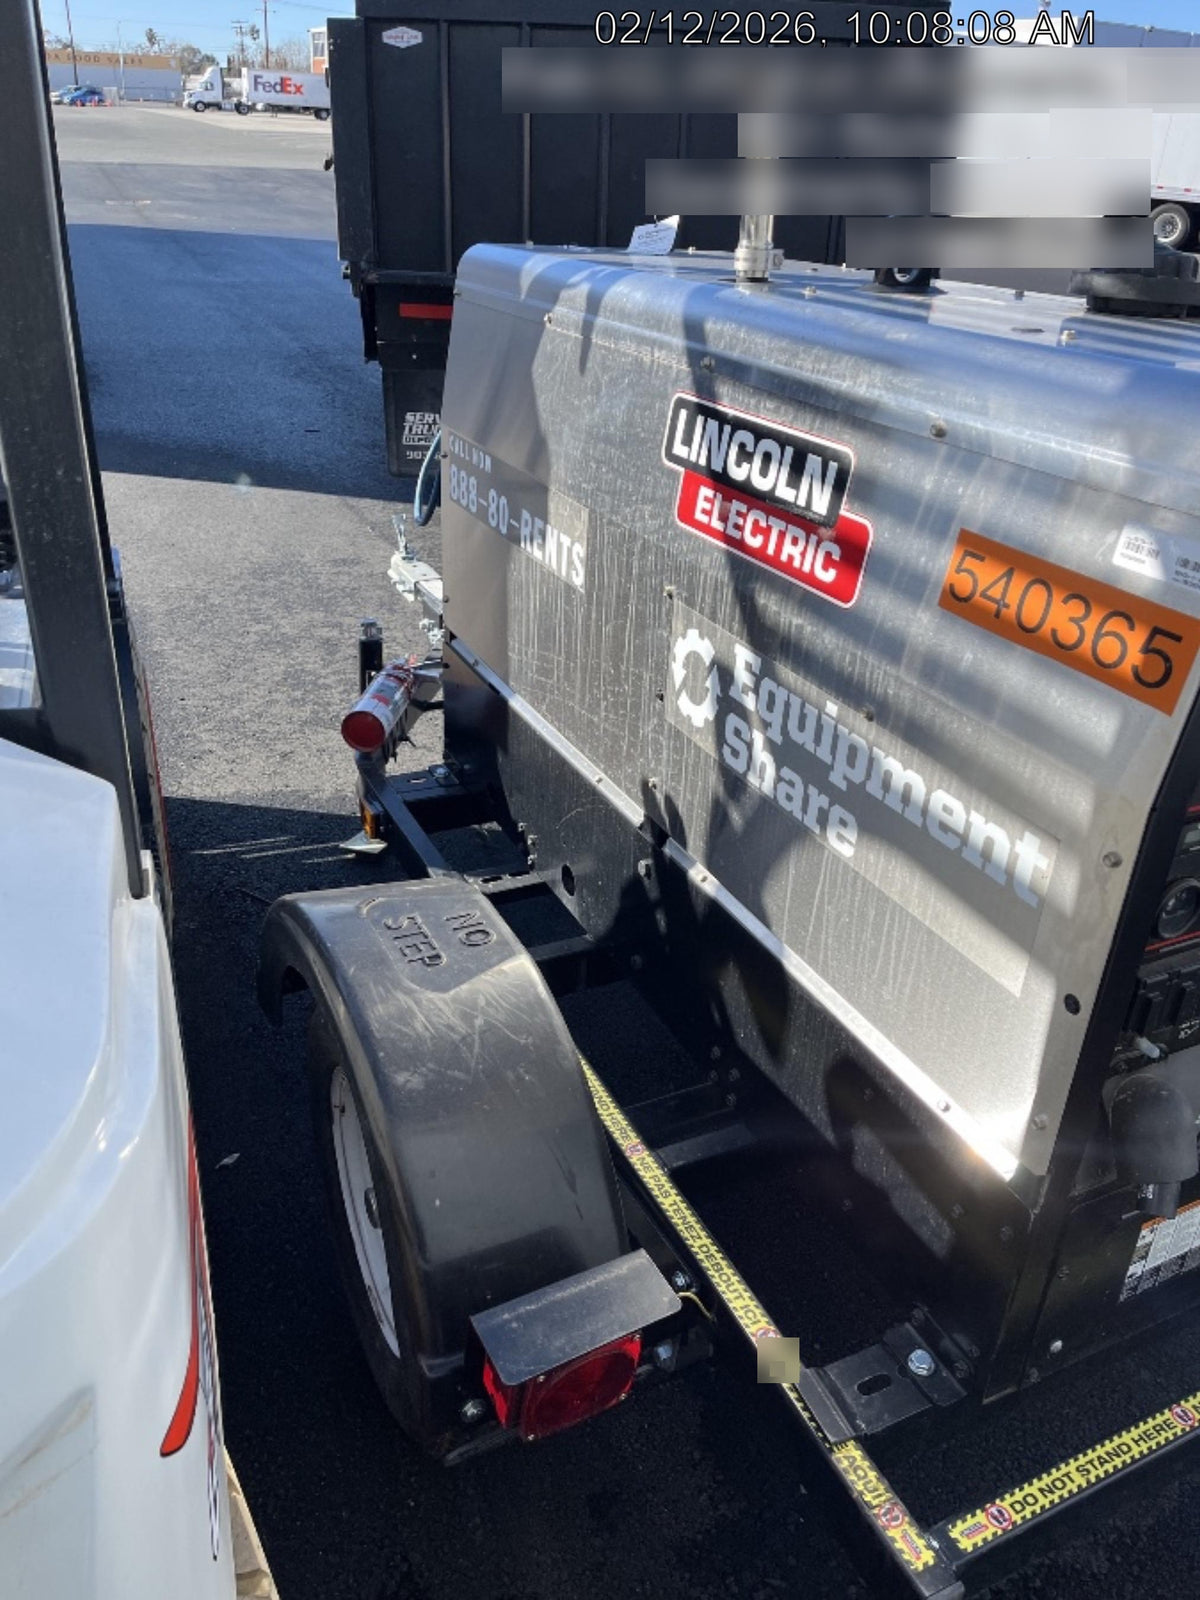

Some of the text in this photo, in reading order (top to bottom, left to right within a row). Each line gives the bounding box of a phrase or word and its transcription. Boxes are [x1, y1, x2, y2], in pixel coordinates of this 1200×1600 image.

[253, 74, 304, 95] FedEx
[672, 407, 839, 518] LINCOLN
[450, 463, 585, 586] 888-80-RENTS
[693, 485, 842, 585] ELECTRIC
[947, 550, 1184, 691] 540365
[728, 642, 1051, 908] Equipment
[381, 911, 447, 968] STEP
[443, 909, 498, 947] NO
[649, 1174, 673, 1200] PAS
[668, 1201, 702, 1244] TENEZ
[699, 1243, 747, 1303] DEBOUT
[739, 1303, 763, 1326] ICI
[842, 1454, 888, 1501] AQUI
[1009, 1417, 1178, 1516] DO NOT STAND HERE
